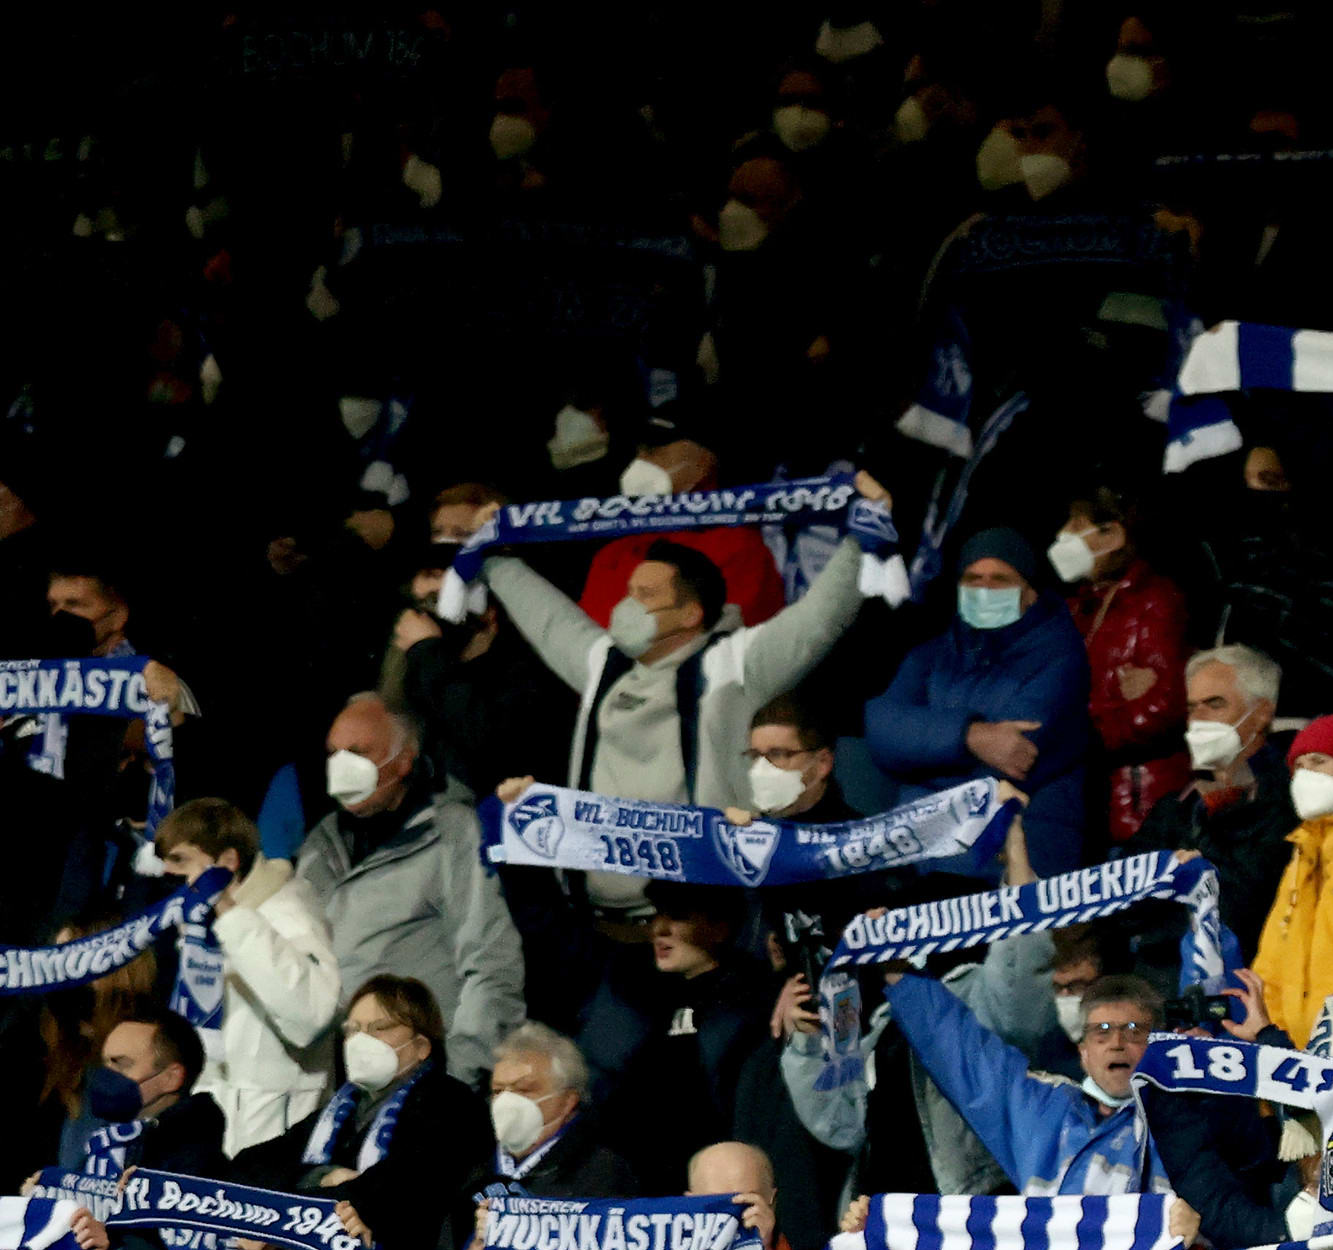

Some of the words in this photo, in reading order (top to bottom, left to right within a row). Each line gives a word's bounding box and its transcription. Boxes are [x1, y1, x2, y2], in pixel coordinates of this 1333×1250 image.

[614, 809, 704, 838] BOCHUM
[601, 834, 684, 874] 1848
[156, 1176, 281, 1229] Bochum
